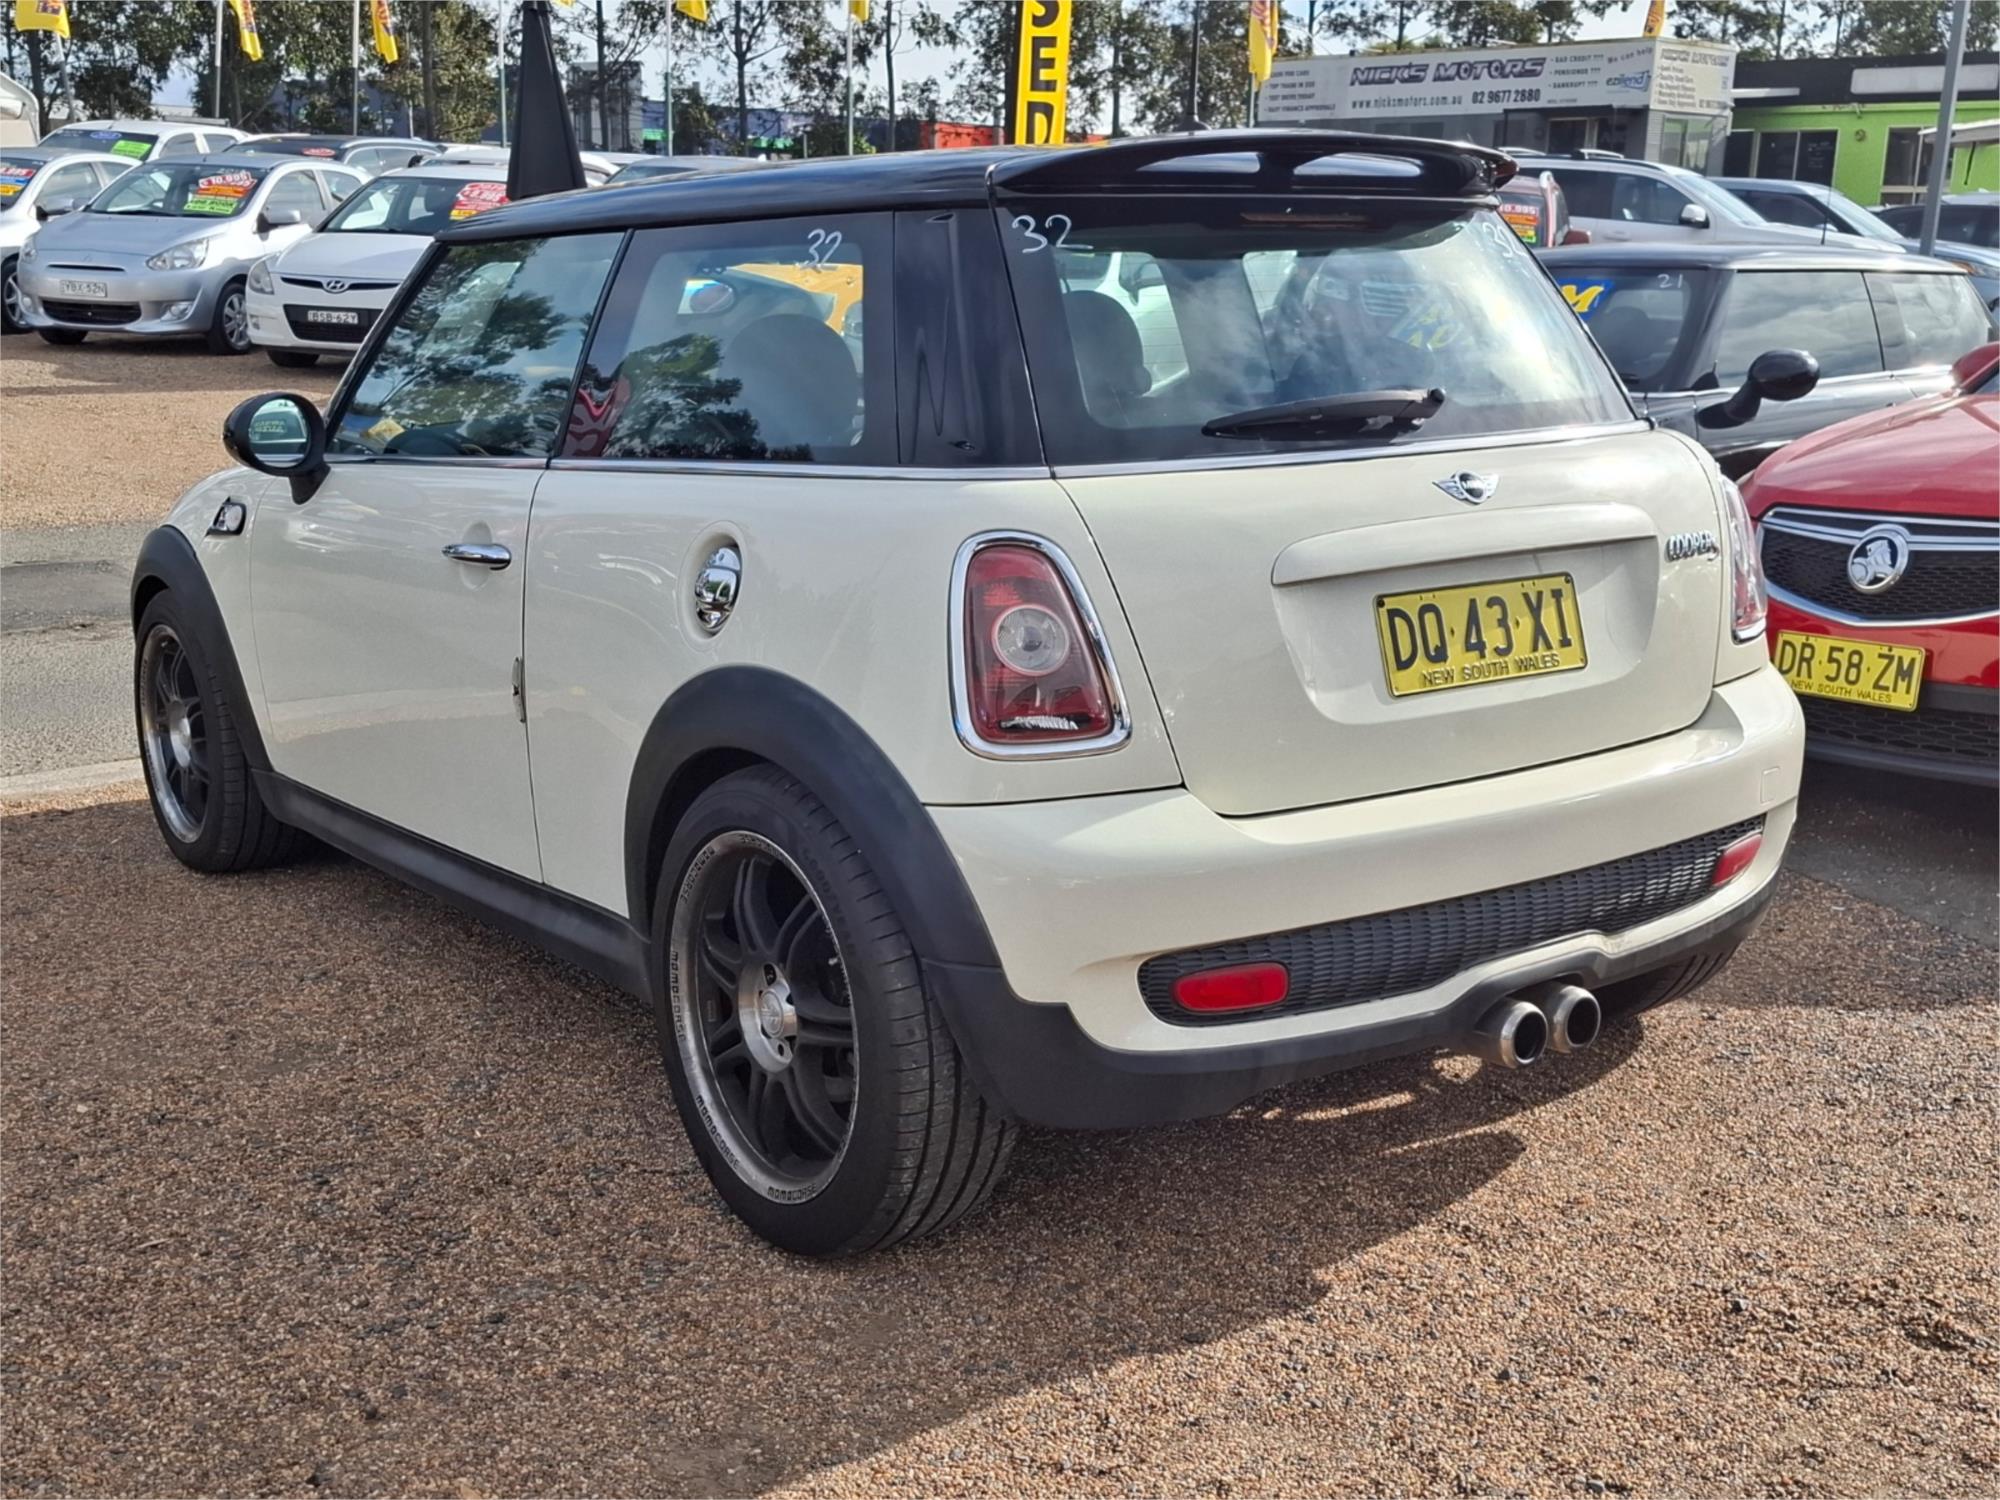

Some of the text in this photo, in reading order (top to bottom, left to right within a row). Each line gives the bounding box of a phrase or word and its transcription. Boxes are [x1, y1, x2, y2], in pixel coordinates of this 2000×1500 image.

[1569, 54, 1591, 62] CREDIT
[1620, 52, 1634, 60] can
[1636, 47, 1653, 57] help
[1432, 58, 1546, 82] MOTORS
[1352, 95, 1462, 109] www.nicksmotors.com.au
[1472, 91, 1484, 104] 02
[1487, 90, 1512, 104] 9677
[1513, 88, 1541, 103] 2880
[1011, 214, 1095, 254] 32
[807, 228, 843, 266] 32
[1656, 273, 1684, 289] 21
[1422, 653, 1561, 687] NEW SOUTH WALES
[1790, 679, 1892, 704] NEW SOUTH WALES
